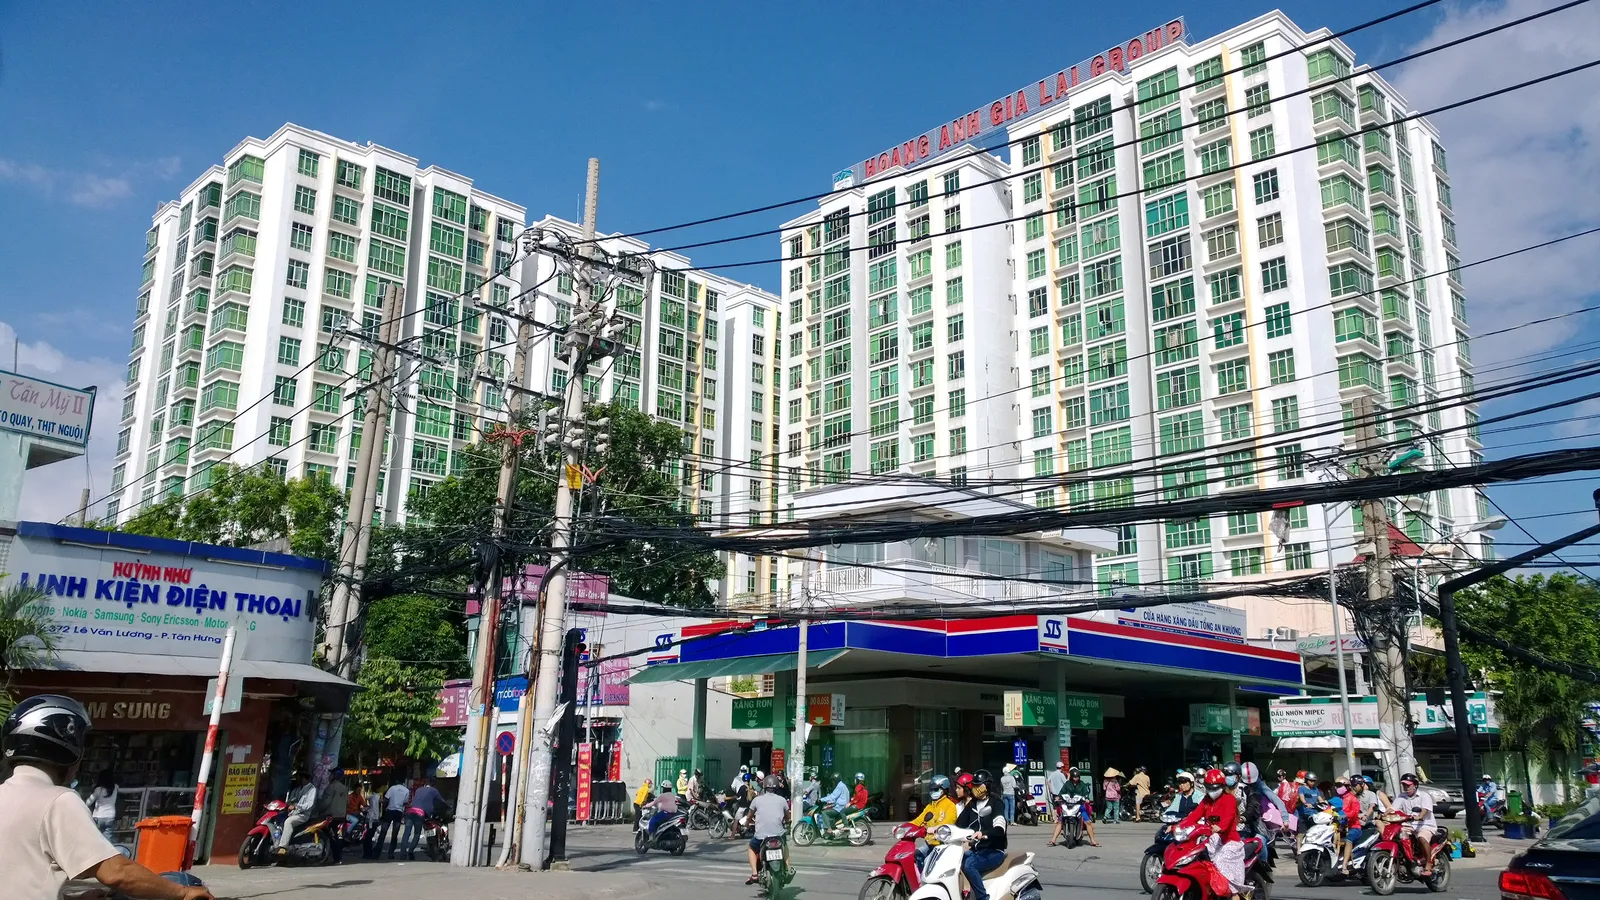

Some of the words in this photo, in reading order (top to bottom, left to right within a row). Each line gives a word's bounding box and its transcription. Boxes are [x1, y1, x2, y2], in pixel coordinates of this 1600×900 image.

[865, 135, 930, 178] HOANG
[939, 110, 980, 150] ANH
[990, 90, 1028, 126] GIA
[1039, 66, 1079, 106] LAI
[1091, 20, 1182, 78] GROUP
[10, 380, 40, 404] Tân
[10, 413, 34, 430] QUAY,
[38, 419, 56, 434] THỊT
[58, 424, 83, 440] NGUỘI
[113, 559, 160, 580] HUỲNH
[164, 567, 193, 584] NHƯ
[20, 572, 87, 598] LINH
[95, 577, 160, 608] KIỆN
[166, 584, 227, 614] ĐIỆN
[234, 592, 301, 622] THOẠI
[63, 608, 87, 618] Nokia
[94, 609, 134, 624] Samsung
[141, 612, 162, 626] Sony
[164, 614, 199, 626] Ericsson
[205, 617, 228, 629] Motor
[1157, 612, 1171, 624] HÀNG
[1214, 624, 1221, 632] AN
[90, 627, 113, 636] Văn
[116, 627, 152, 640] Lương
[195, 634, 221, 644] Hưng
[1044, 619, 1062, 639] STS
[756, 699, 772, 708] RON
[1043, 697, 1055, 705] RON
[1332, 708, 1344, 724] RỬ
[1352, 713, 1363, 724] XE
